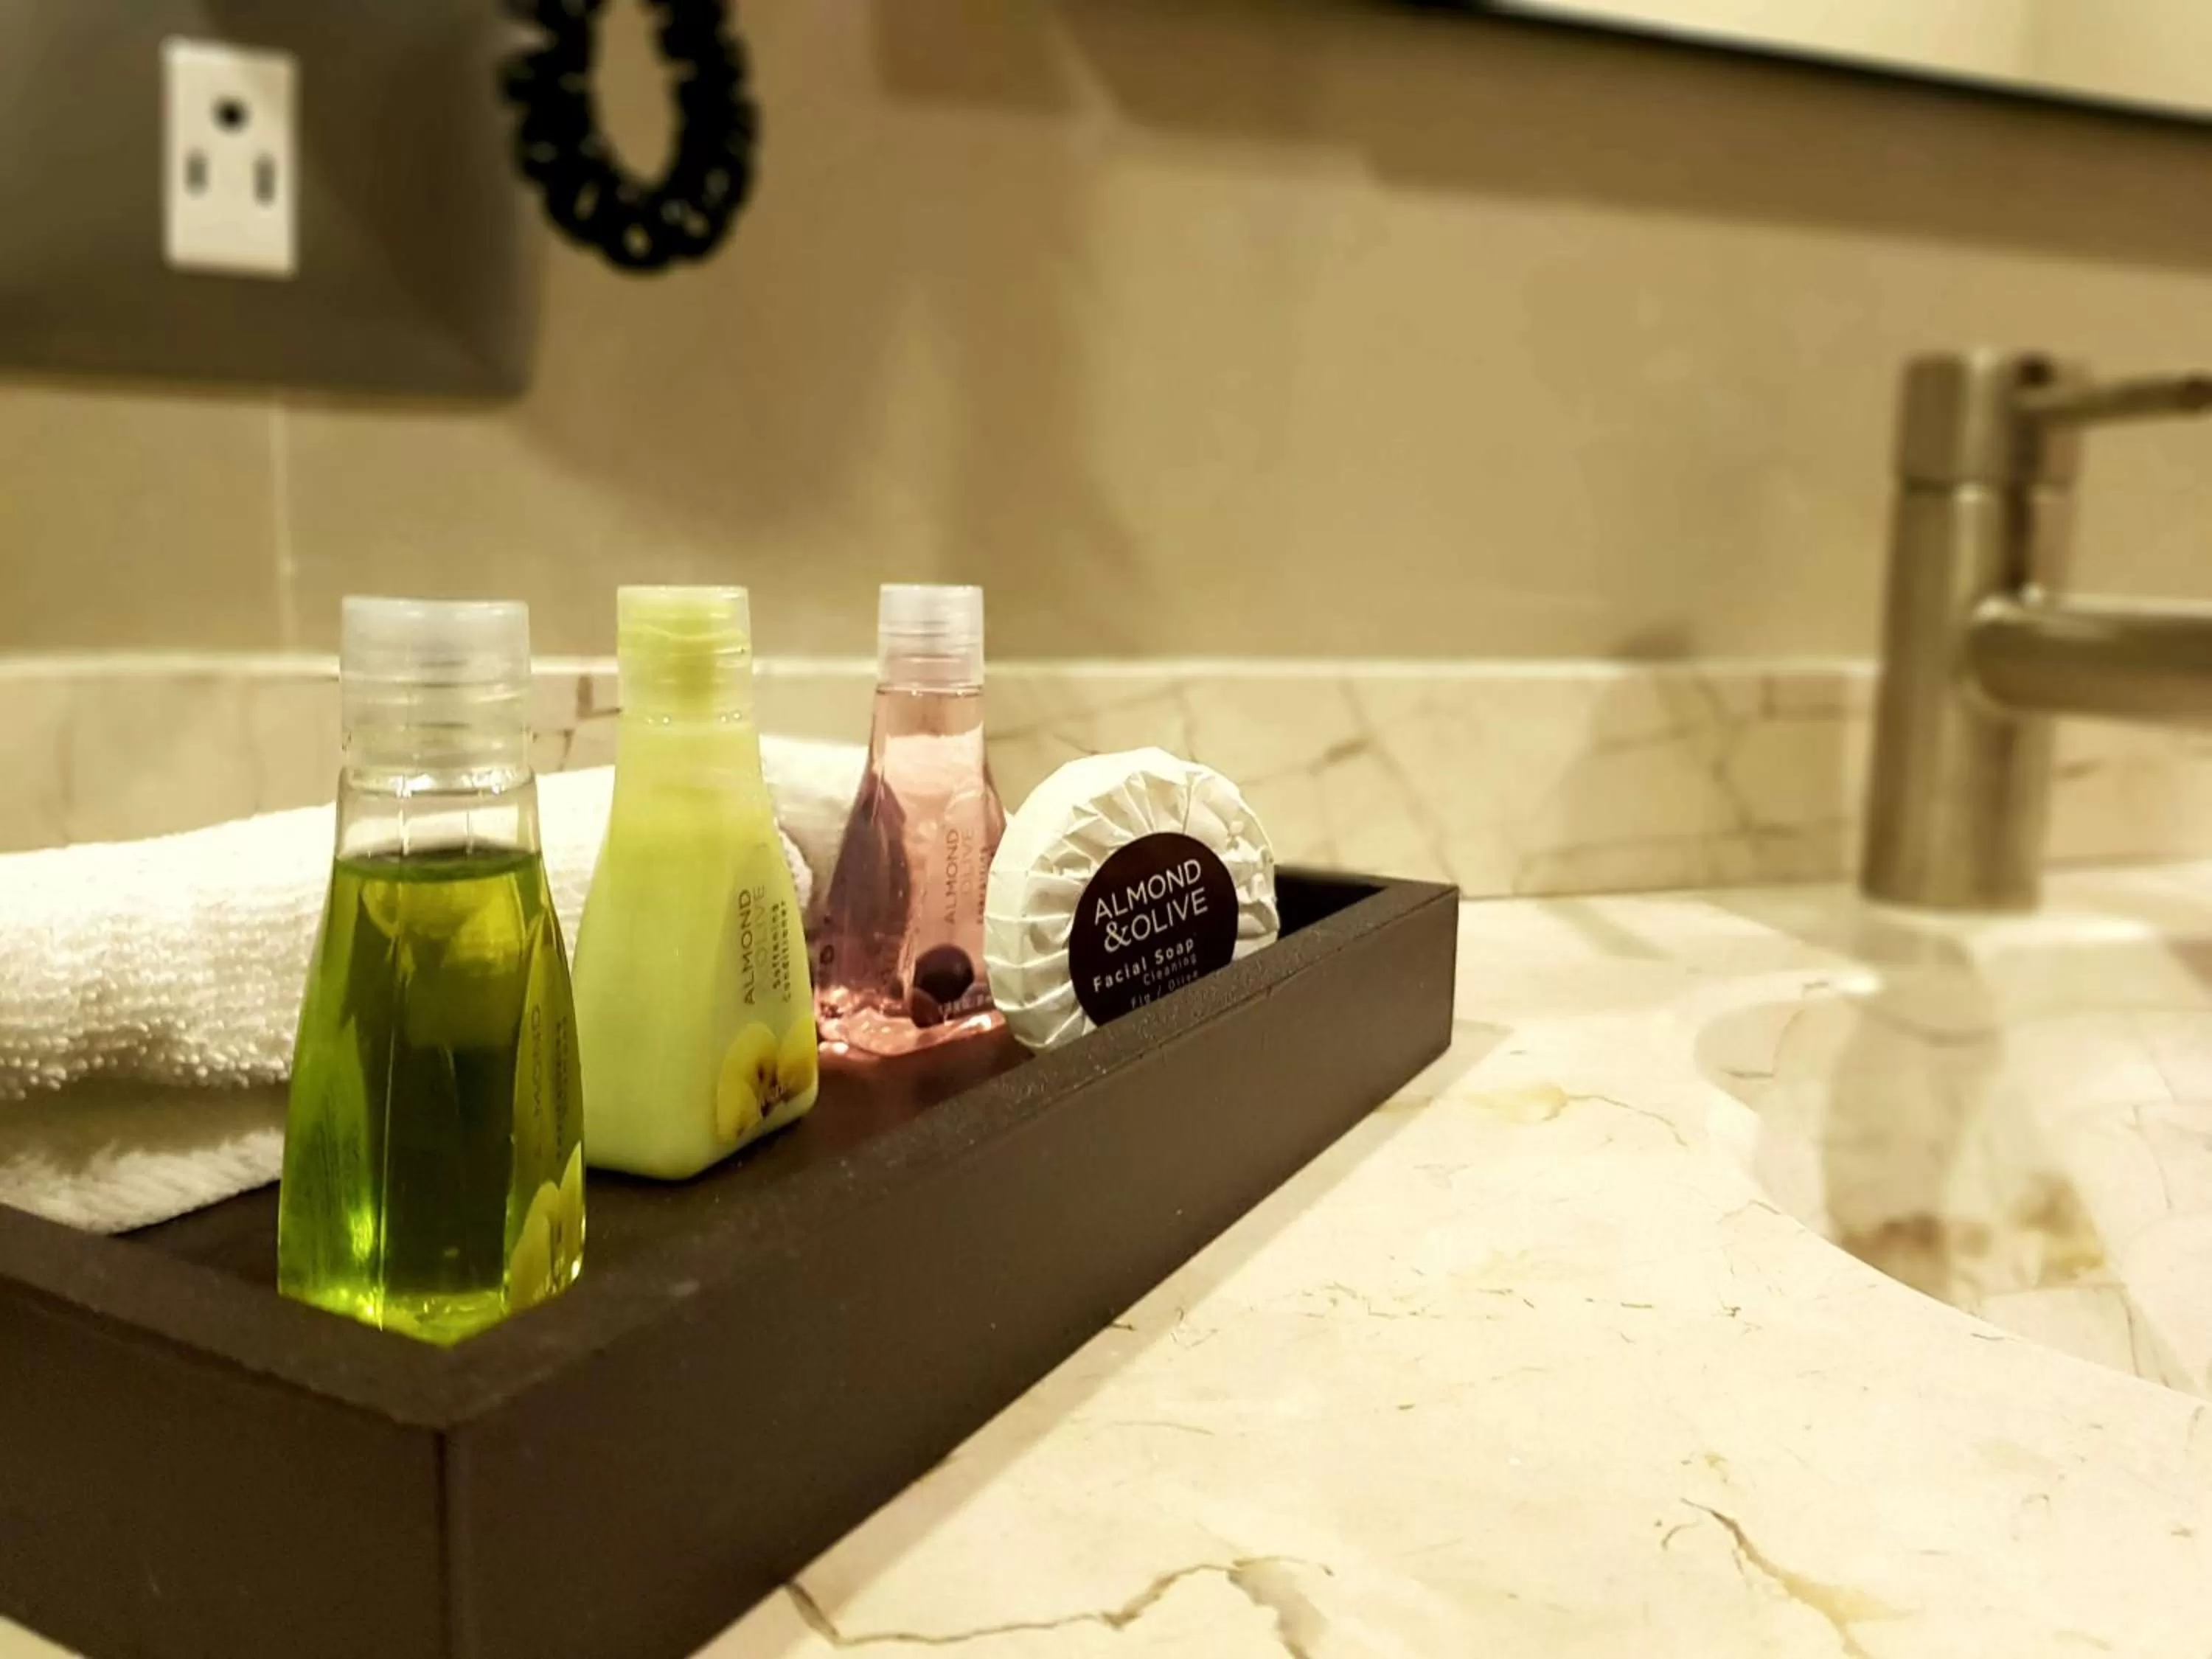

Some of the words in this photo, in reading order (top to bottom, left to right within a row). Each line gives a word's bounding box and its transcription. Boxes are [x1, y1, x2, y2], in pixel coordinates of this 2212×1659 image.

[944, 829, 959, 925] ALMOND
[1094, 859, 1202, 925] ALMOND
[739, 888, 755, 1006] ALMOND
[1104, 886, 1208, 953] &OLIVE
[1092, 956, 1147, 992] Facial
[1154, 937, 1194, 964] Soap
[1143, 953, 1197, 986] Cleaning
